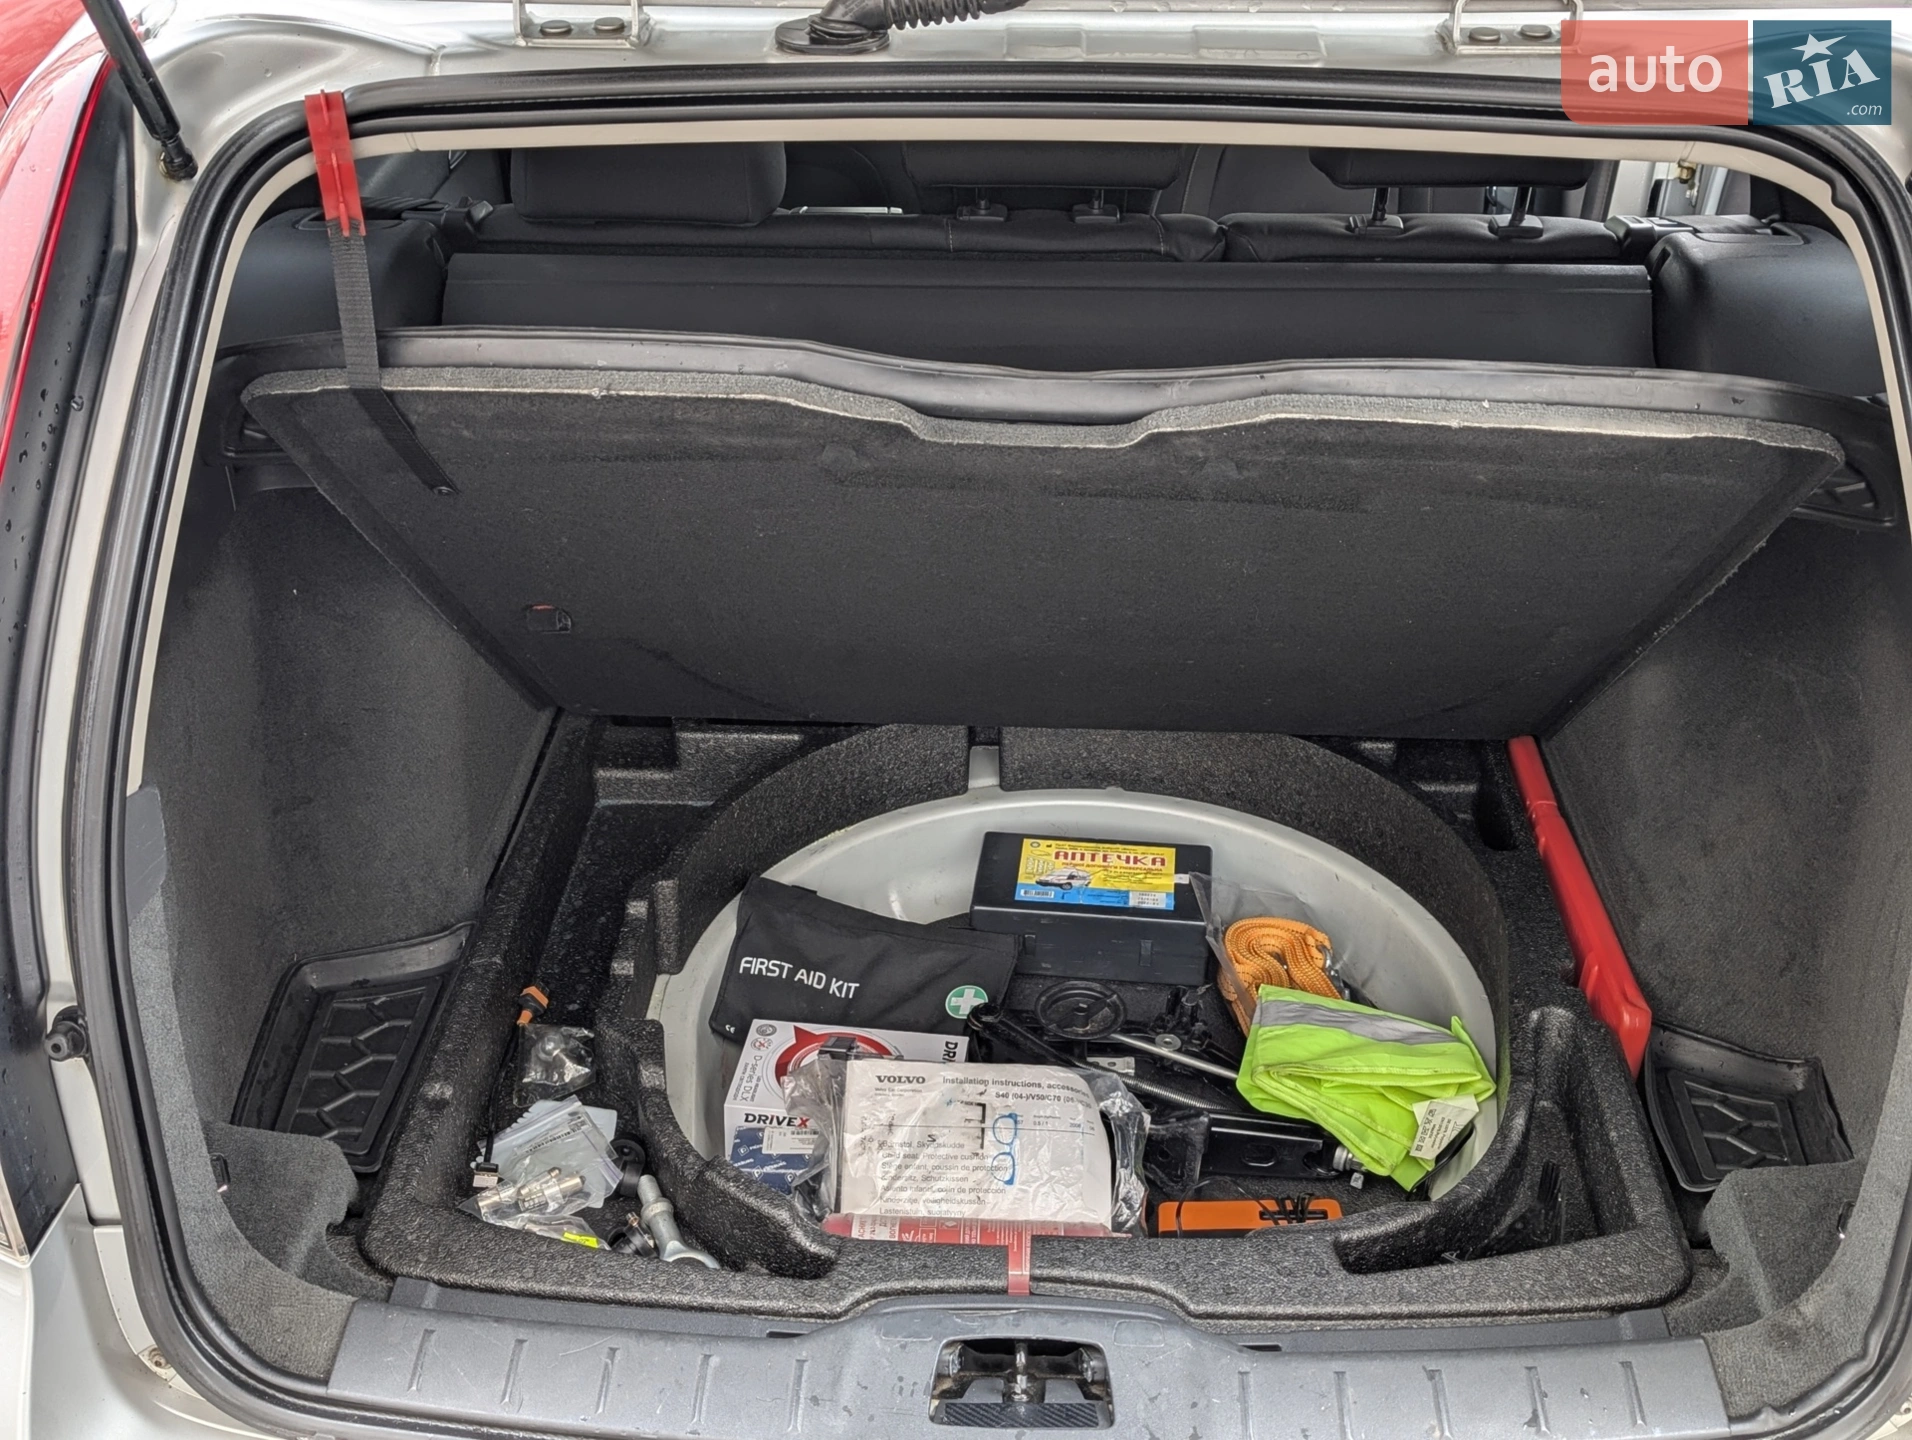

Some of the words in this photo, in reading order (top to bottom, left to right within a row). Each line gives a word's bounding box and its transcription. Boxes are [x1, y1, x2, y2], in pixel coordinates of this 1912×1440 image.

[1054, 850, 1166, 867] АПТЕЧКА
[739, 956, 793, 979] FIRST
[794, 968, 827, 990] AID
[829, 977, 860, 999] KIT
[746, 1055, 763, 1084] D-series
[875, 1075, 926, 1084] VOLVO
[942, 1076, 990, 1086] Installation
[991, 1078, 1045, 1089] instructions,
[739, 1085, 753, 1102] DLX
[744, 1113, 811, 1129] DRIVEX
[922, 1152, 959, 1160] Protective
[972, 1164, 1008, 1173] protection
[921, 1174, 968, 1182] Schutzkissen
